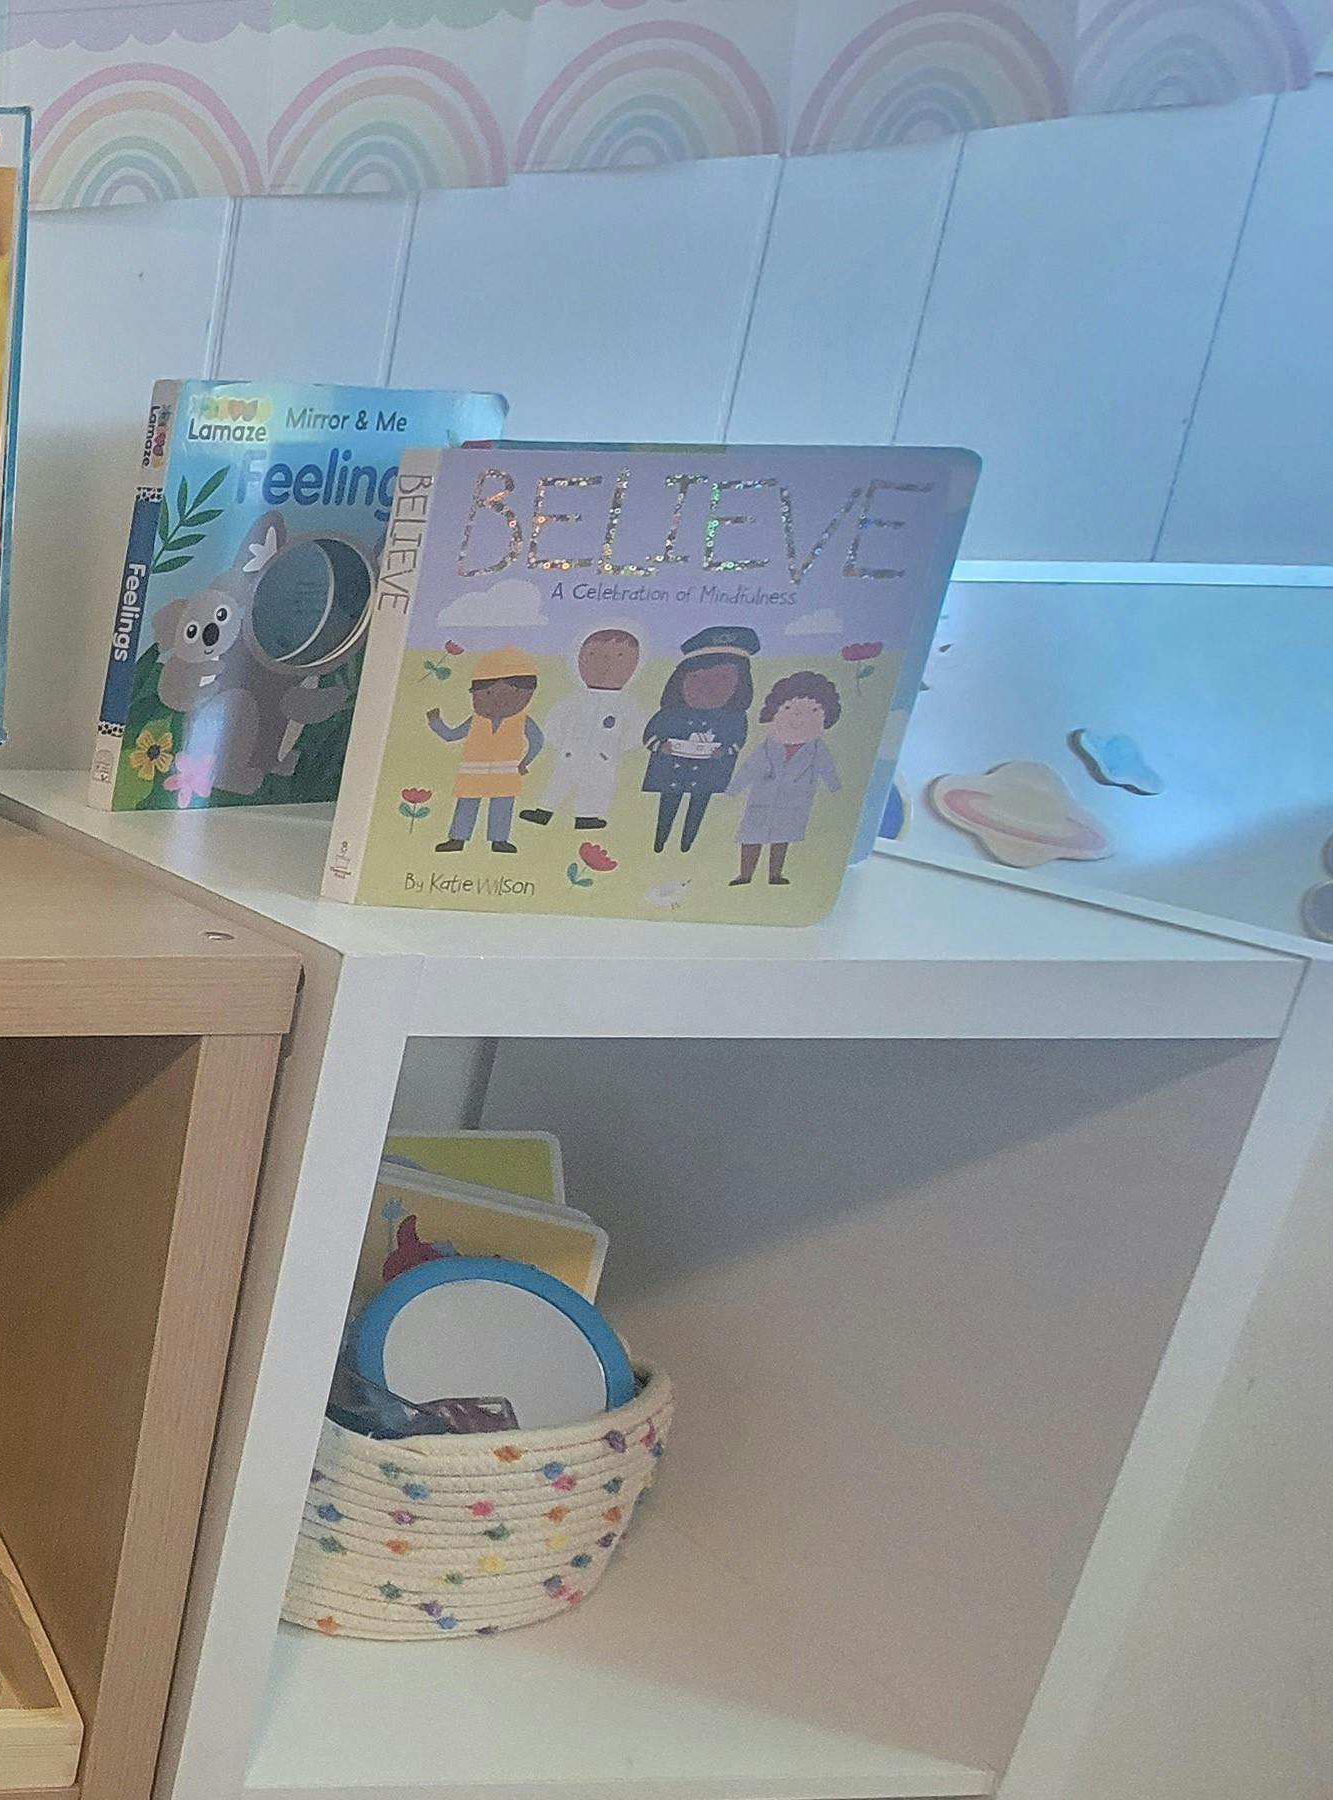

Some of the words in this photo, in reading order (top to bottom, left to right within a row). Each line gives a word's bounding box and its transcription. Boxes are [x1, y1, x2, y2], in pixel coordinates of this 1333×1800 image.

[142, 405, 161, 469] Lamaze
[187, 418, 268, 443] Lamaze
[285, 407, 348, 431] Mirror
[355, 409, 369, 430] &
[376, 409, 408, 432] Me
[378, 474, 433, 614] BELIEVE
[458, 467, 932, 585] BELIEVE
[113, 563, 147, 662] Feelings
[551, 582, 564, 601] A
[571, 582, 669, 602] Celebration
[675, 586, 693, 602] of
[699, 586, 797, 606] Mindfulness
[404, 872, 424, 894] By
[429, 873, 475, 893] Katie
[477, 877, 535, 897] Wilson
